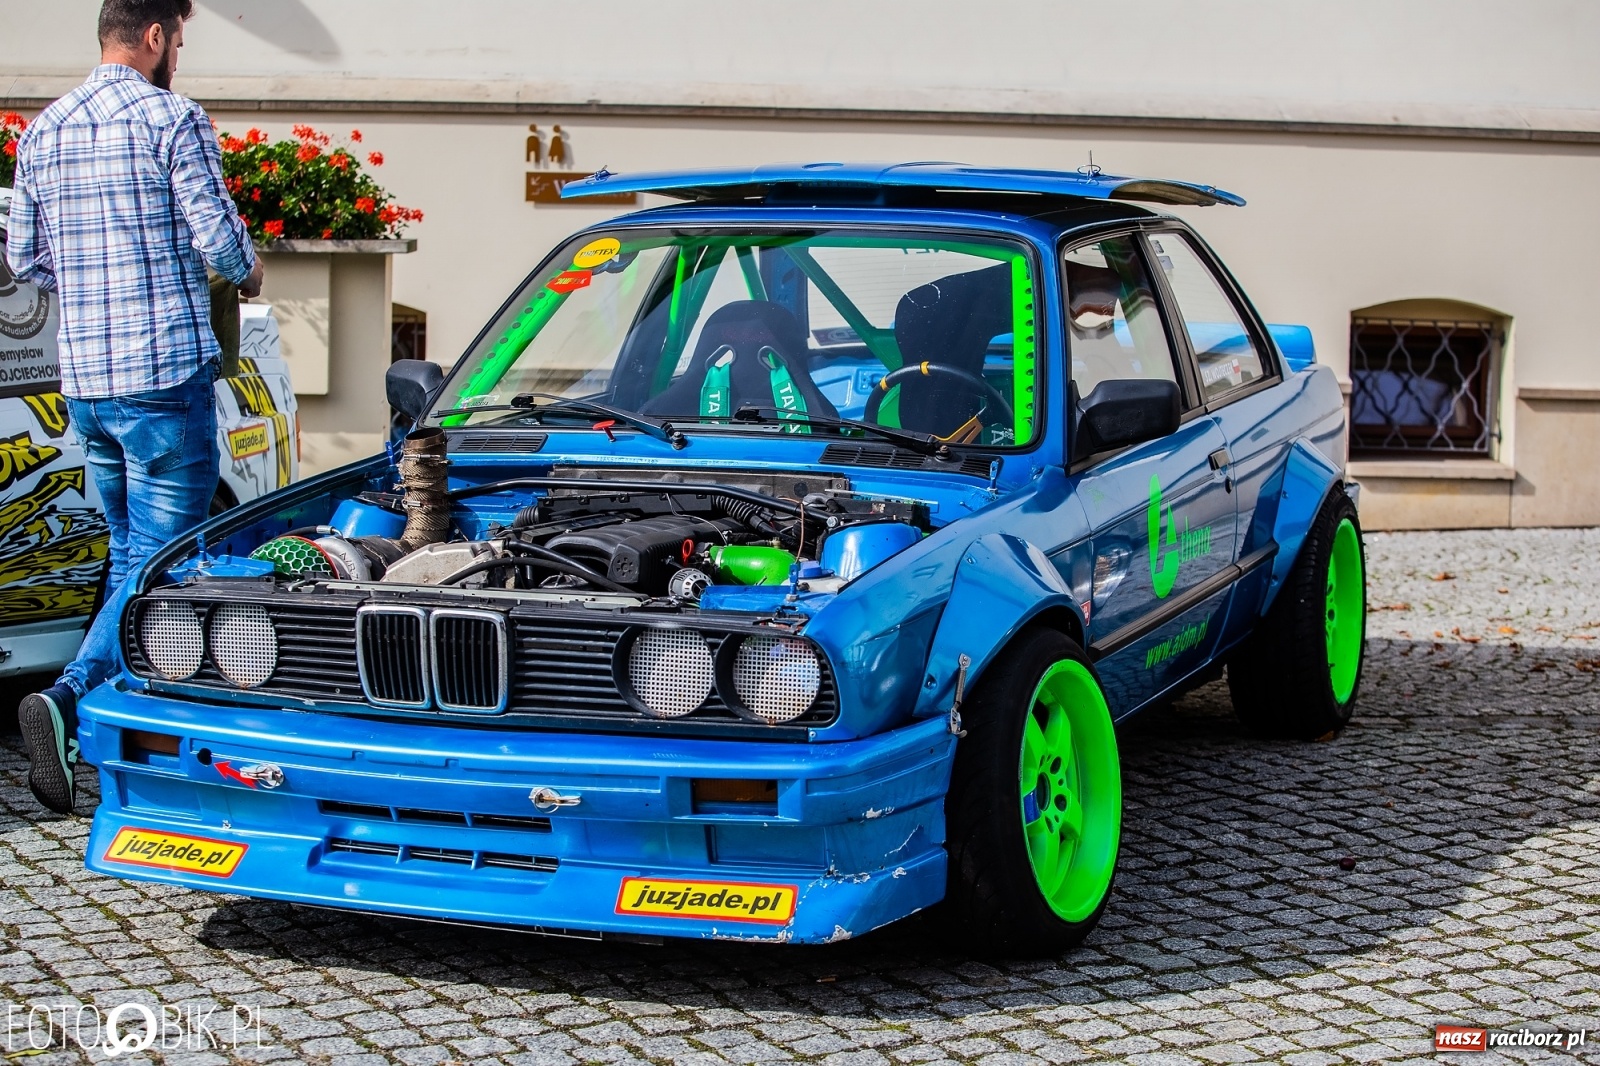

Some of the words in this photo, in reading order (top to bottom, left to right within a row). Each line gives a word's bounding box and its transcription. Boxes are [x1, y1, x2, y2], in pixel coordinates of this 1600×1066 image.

[234, 429, 266, 455] juzjade.pl
[117, 834, 235, 867] juzjade.pl
[631, 884, 782, 915] juzjade.pl
